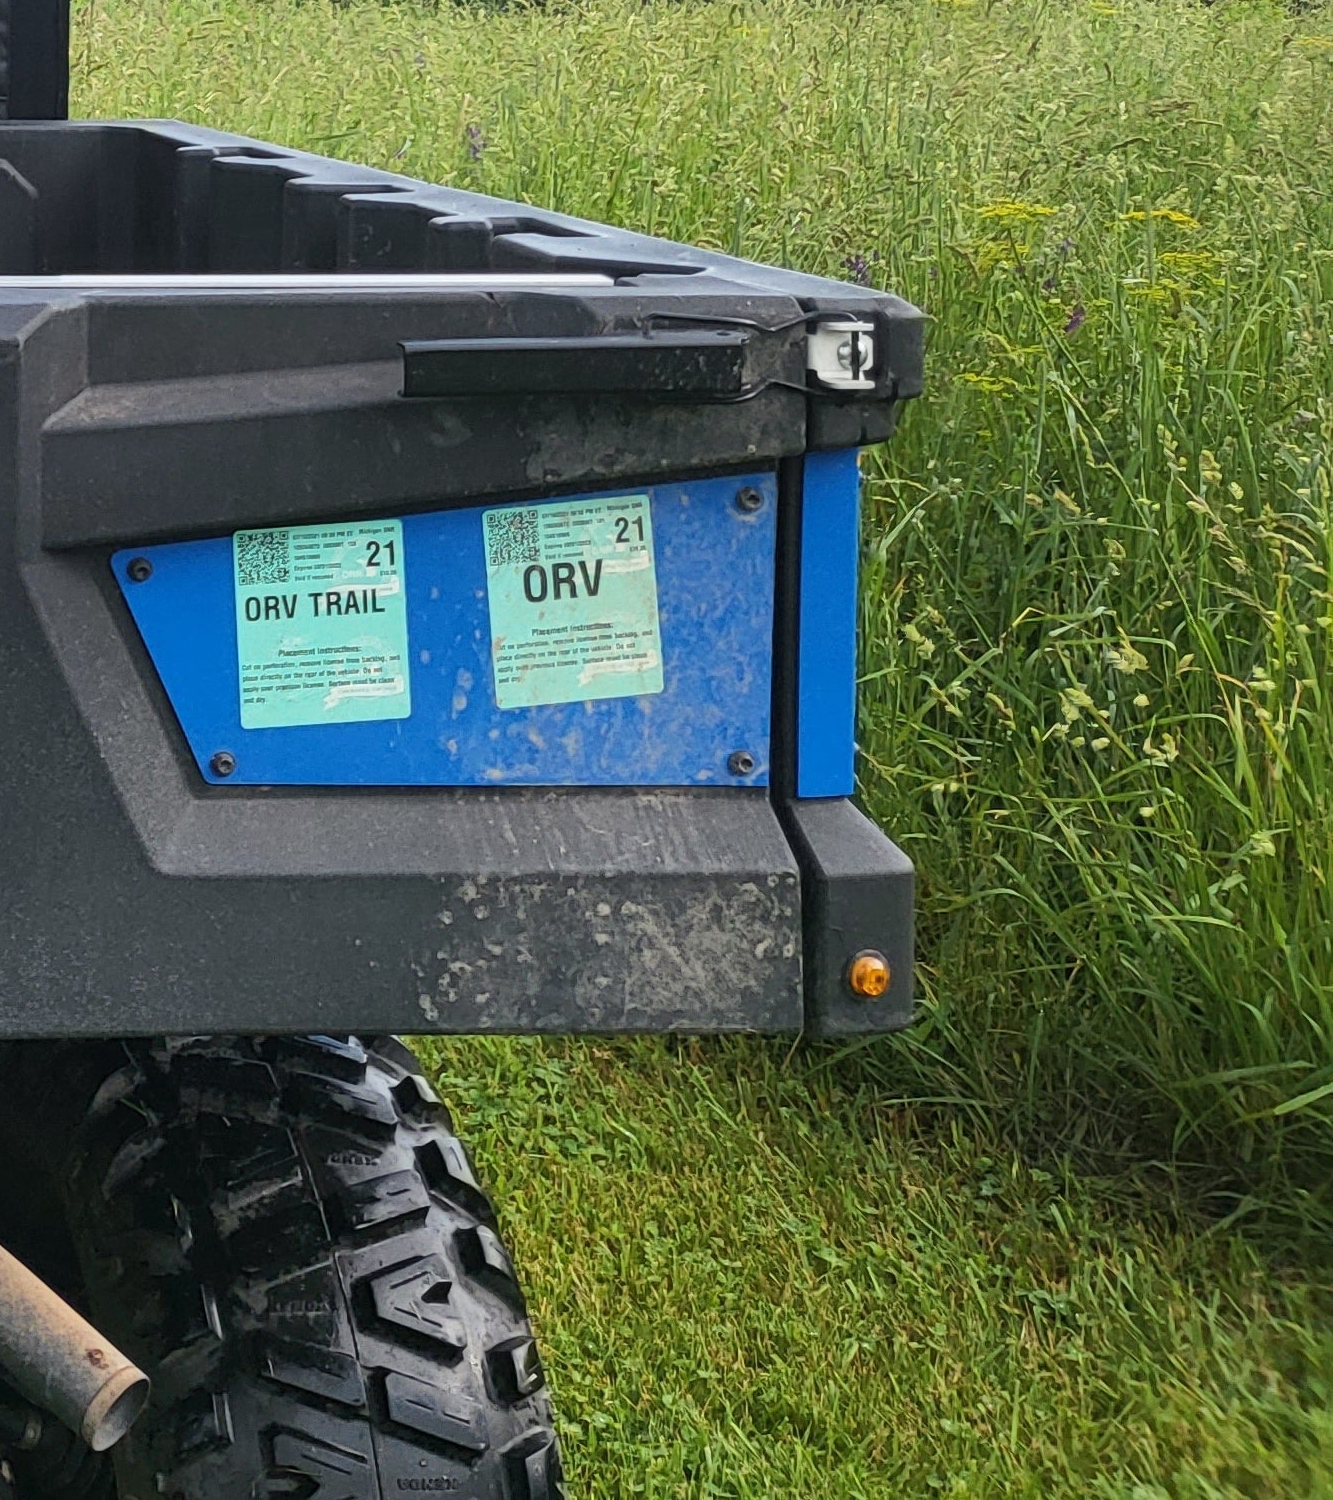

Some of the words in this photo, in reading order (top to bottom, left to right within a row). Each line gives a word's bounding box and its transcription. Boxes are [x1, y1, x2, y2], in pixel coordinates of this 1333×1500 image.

[615, 516, 644, 543] 21
[366, 540, 394, 567] 21
[523, 559, 603, 603] ORV
[245, 594, 297, 622] ORV
[308, 589, 385, 617] TRAIL
